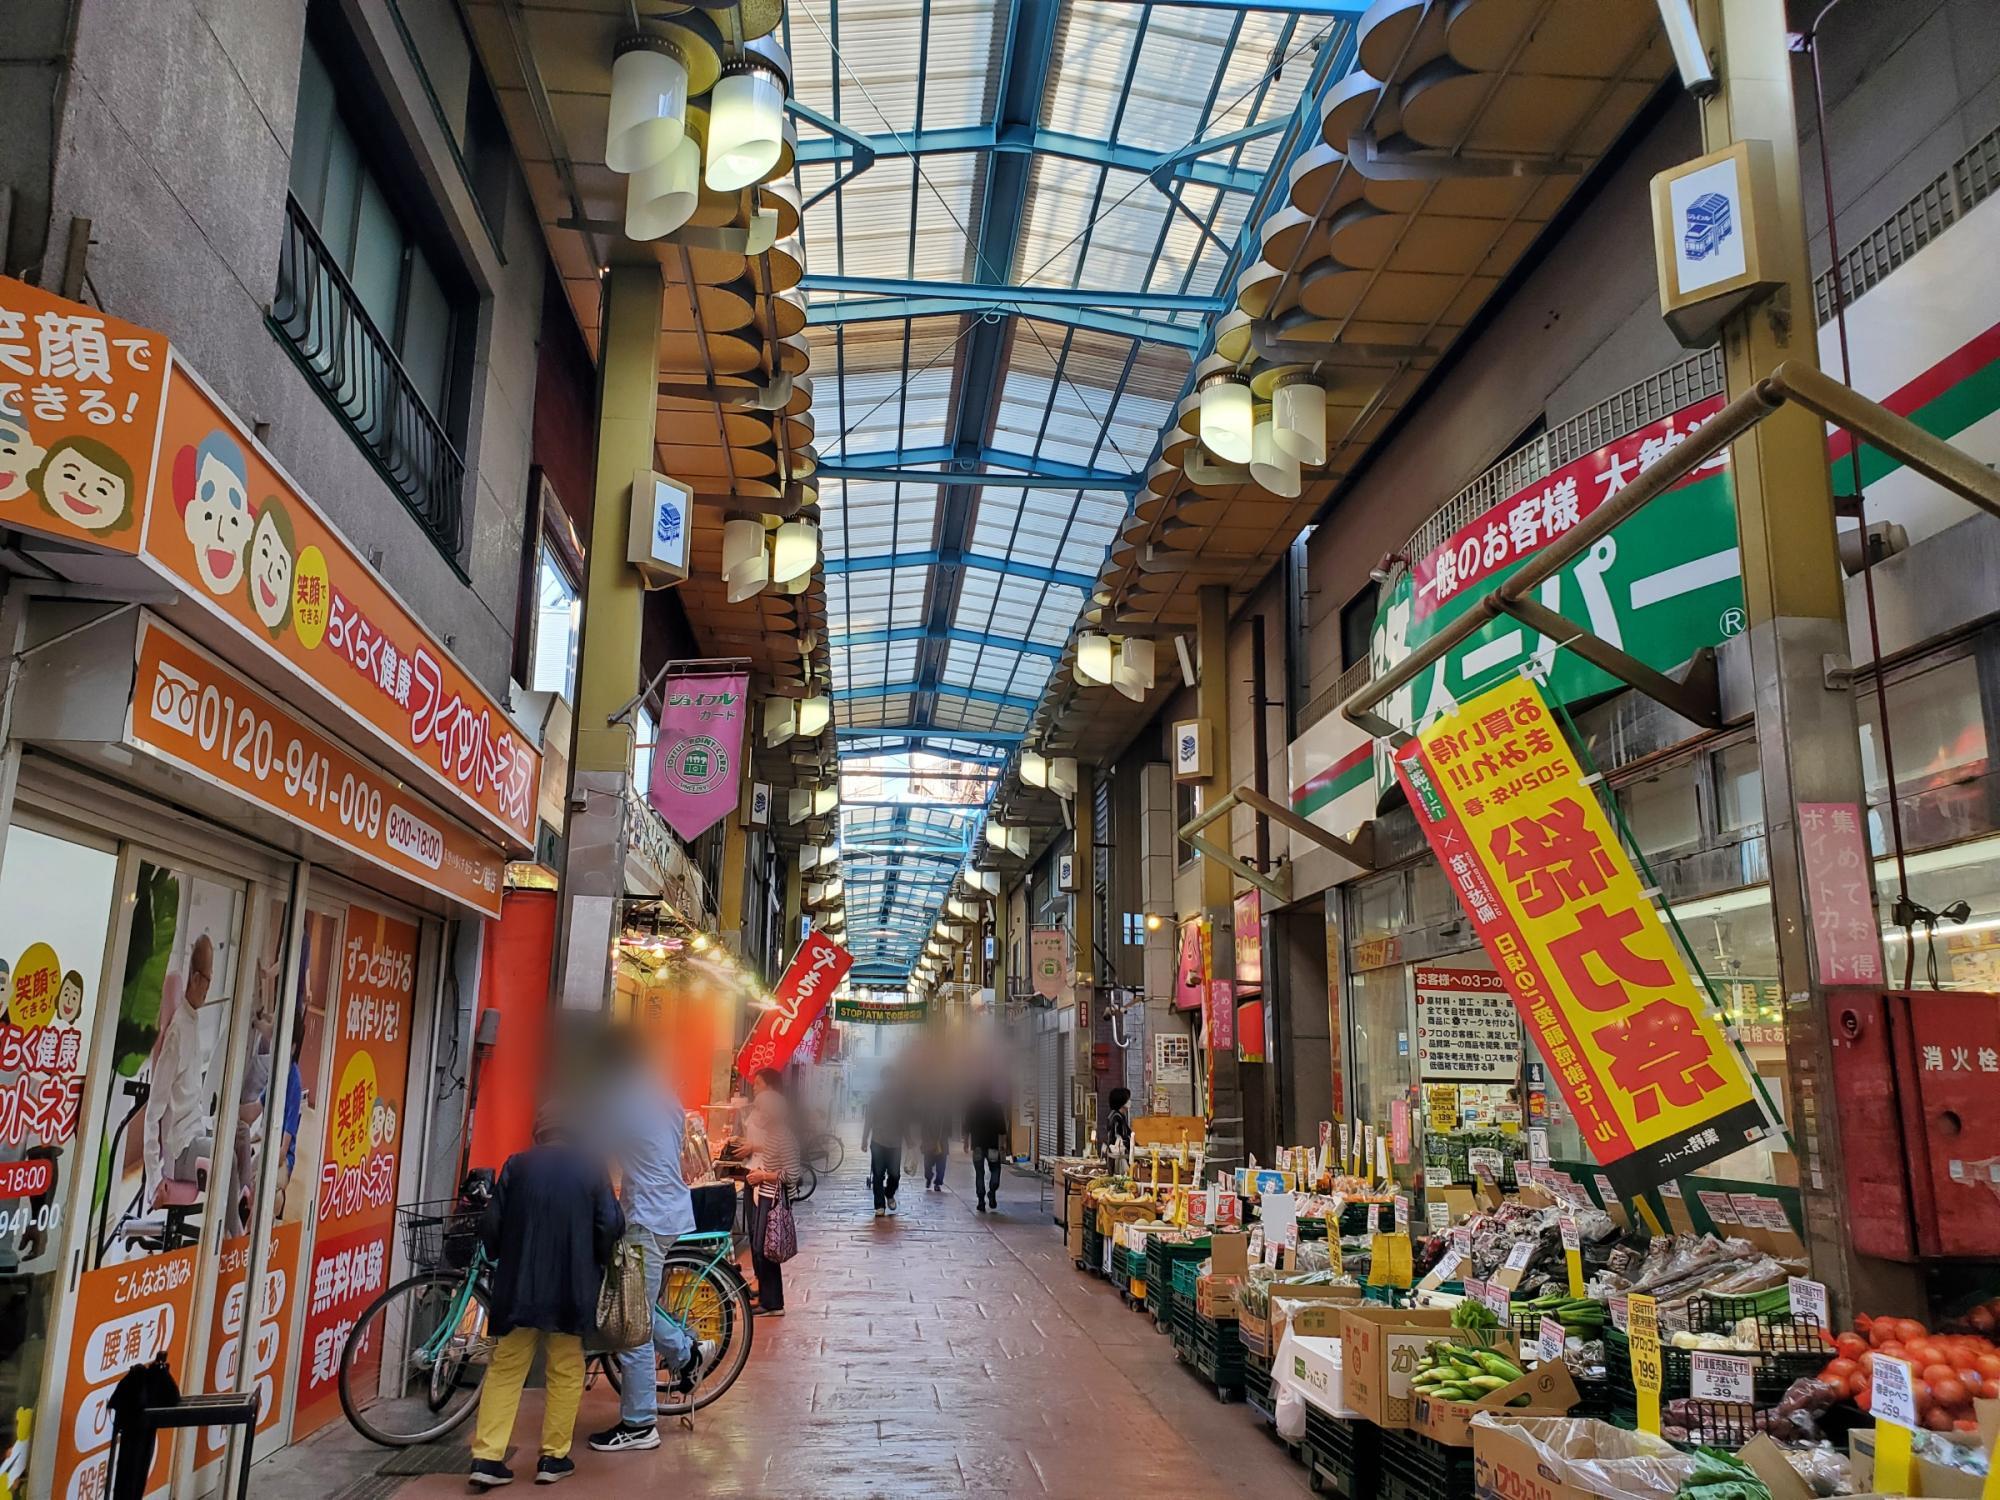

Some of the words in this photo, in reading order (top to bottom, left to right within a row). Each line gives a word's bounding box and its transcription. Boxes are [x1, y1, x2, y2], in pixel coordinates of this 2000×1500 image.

[0, 306, 152, 385] 笑顔で
[0, 383, 139, 424] できる!
[1418, 476, 1581, 601] 一般のお客様
[297, 574, 326, 607] 笑顔で
[299, 607, 325, 626] できる!
[328, 594, 413, 710] らくらく健康
[669, 693, 740, 706] ジョイフル
[699, 710, 736, 721] カード
[411, 648, 532, 828] フィットネス
[667, 744, 686, 769] JOYFUL
[688, 737, 716, 748] POINT
[715, 748, 726, 773] CARD
[198, 684, 382, 840] 0120-941-009
[1803, 809, 1849, 980] ポイントカード
[1831, 810, 1877, 980] 集めてお得
[15, 968, 58, 1001] 笑顔で
[347, 936, 413, 992] ずっと歩ける
[1416, 973, 1503, 988] お客様への3つの
[20, 999, 54, 1020] できる!
[346, 994, 401, 1042] 体作りを!
[0, 1026, 80, 1069] らく健康
[1922, 1046, 2000, 1073] 消火栓
[337, 1079, 374, 1139] 笑顔で
[339, 1122, 370, 1157] できる!
[320, 1154, 395, 1221] フィットネス
[114, 1258, 192, 1305] こんなお悩み
[312, 1238, 384, 1317] 無料体験
[101, 1322, 143, 1372] 腰痛
[1638, 1360, 1656, 1380] 199
[1705, 1374, 1740, 1386] さつまいも
[1713, 1387, 1732, 1398] 39
[1882, 1402, 1900, 1419] 259
